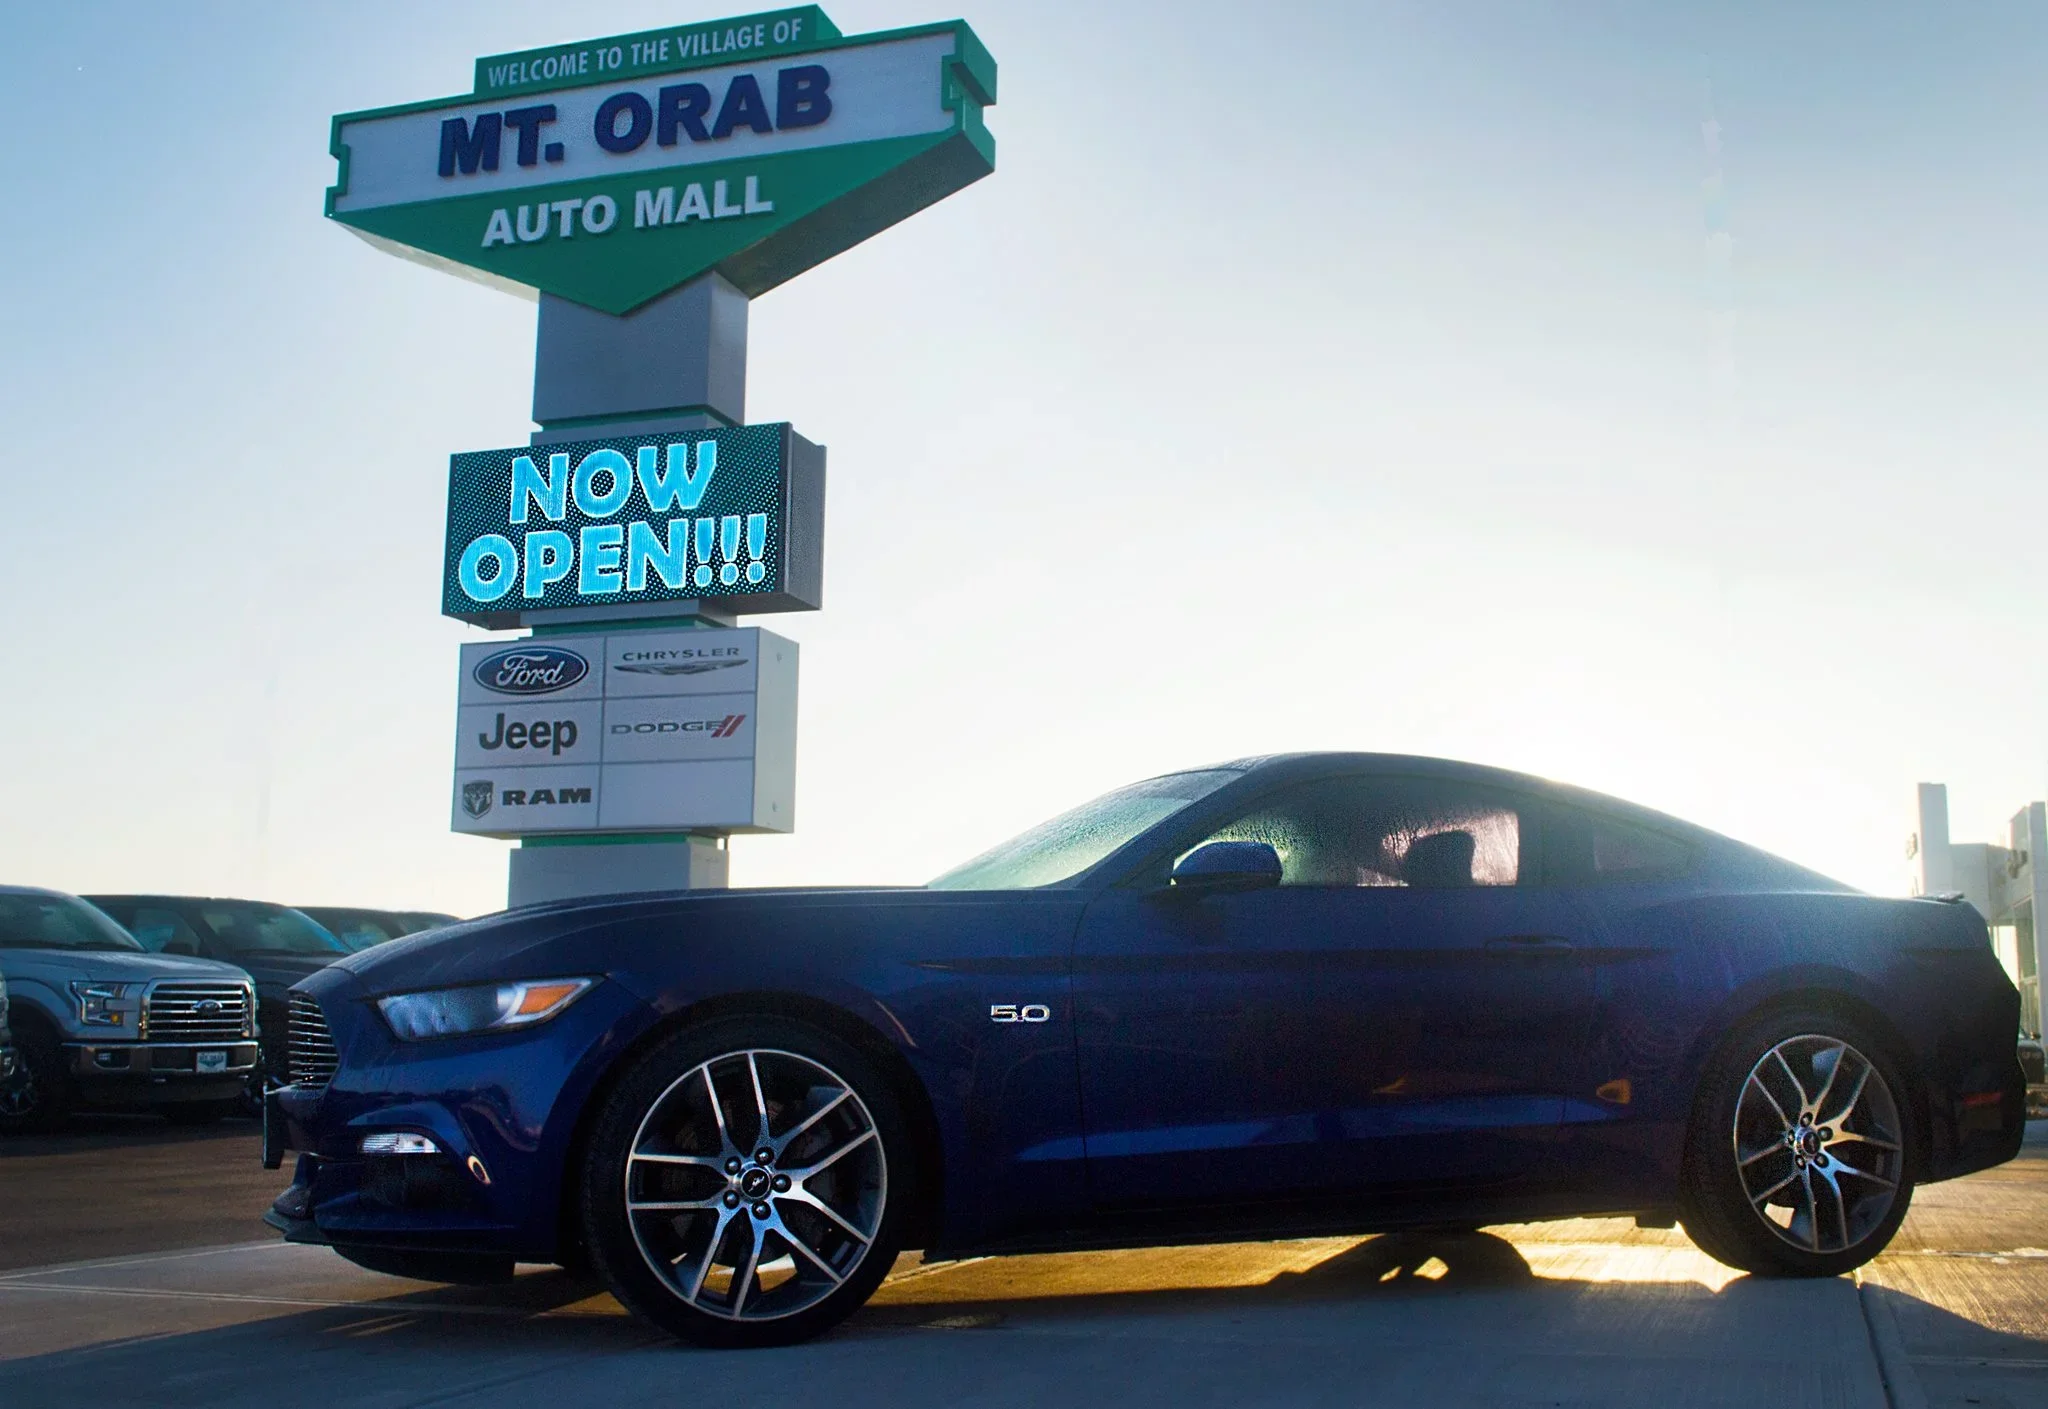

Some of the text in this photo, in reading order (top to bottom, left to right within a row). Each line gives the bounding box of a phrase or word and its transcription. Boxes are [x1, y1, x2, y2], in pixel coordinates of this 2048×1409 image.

[488, 18, 802, 88] WELCOME TO THE VILLAGE OF
[438, 63, 833, 177] MT. ORAB
[481, 176, 774, 248] AUTO MALL
[509, 440, 717, 524] NOW
[458, 512, 767, 602] OPEN!!!
[496, 654, 565, 686] Ford
[622, 647, 740, 661] CHRYSLER
[479, 713, 578, 756] Jeep
[502, 788, 592, 806] RAM
[990, 1004, 1051, 1022] 5.0
